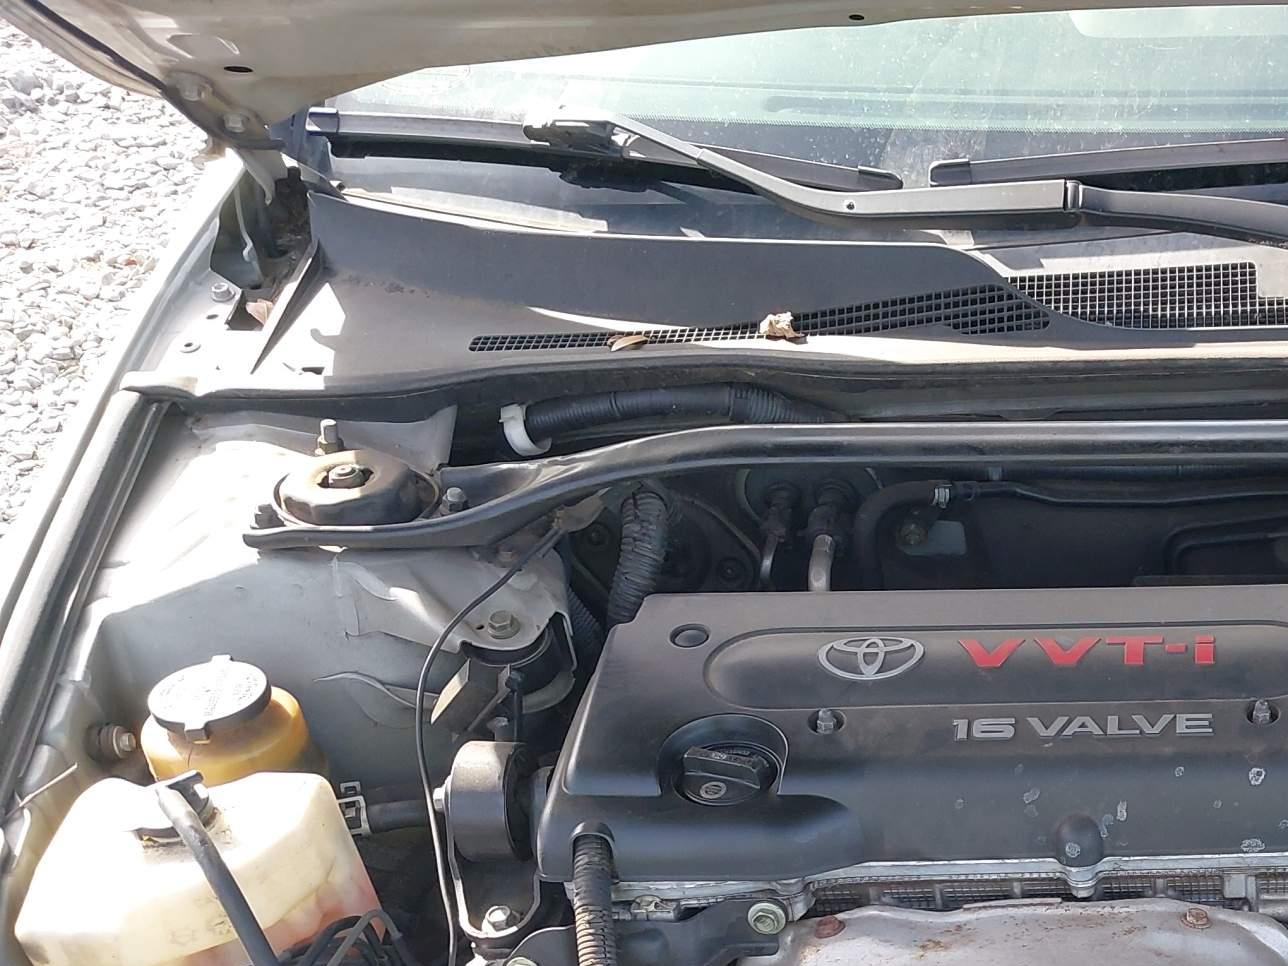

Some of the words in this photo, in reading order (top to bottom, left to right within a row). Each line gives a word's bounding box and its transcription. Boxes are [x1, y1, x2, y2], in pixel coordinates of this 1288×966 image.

[957, 633, 1216, 669] VVT-i
[953, 717, 1016, 741] 16
[1026, 712, 1214, 738] VALVE
